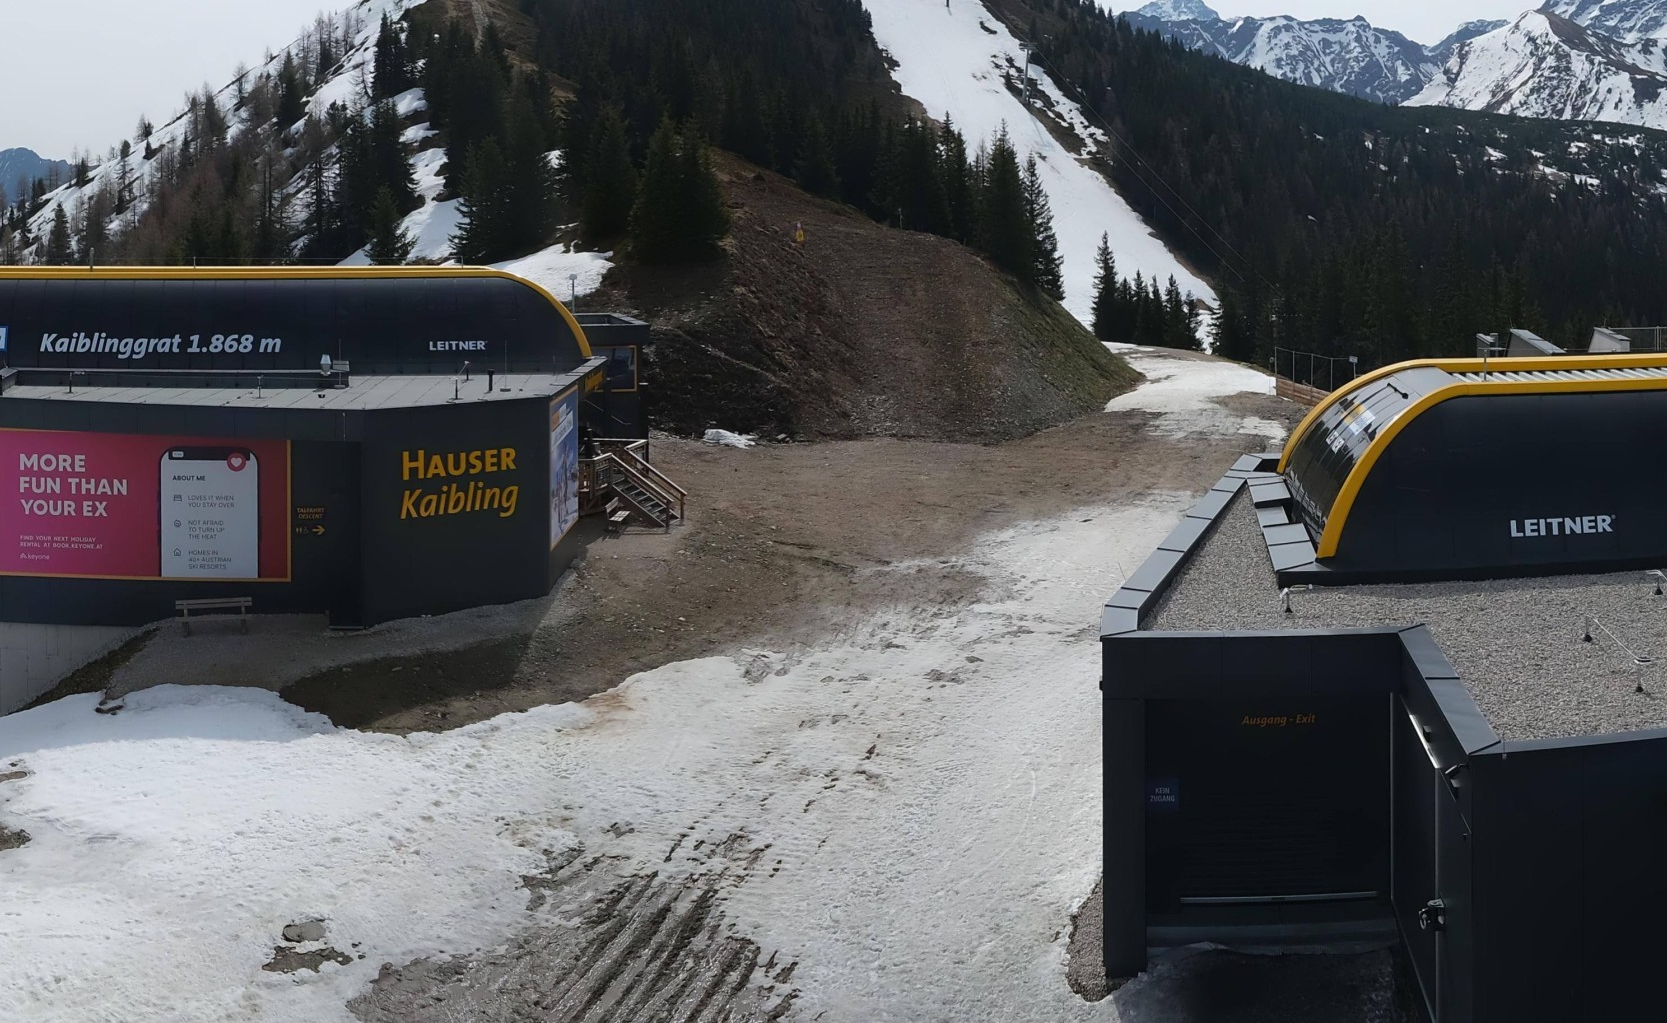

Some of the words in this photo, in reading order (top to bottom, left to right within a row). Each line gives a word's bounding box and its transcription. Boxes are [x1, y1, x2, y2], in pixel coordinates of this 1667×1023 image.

[40, 333, 182, 359] Kaiblinggrat
[187, 334, 254, 353] 1.868
[259, 337, 282, 353] m
[429, 340, 486, 351] LEITNER
[20, 453, 86, 472] MORE
[402, 447, 517, 481] HAUSER
[20, 477, 60, 494] FUN
[68, 478, 127, 495] THAN
[21, 499, 76, 516] YOUR
[83, 501, 107, 517] EX
[400, 481, 519, 519] Kaibling
[1510, 515, 1616, 537] LEITNER
[27, 553, 50, 561] keyone
[1241, 715, 1287, 728] Ausgang
[1296, 713, 1316, 724] Exit
